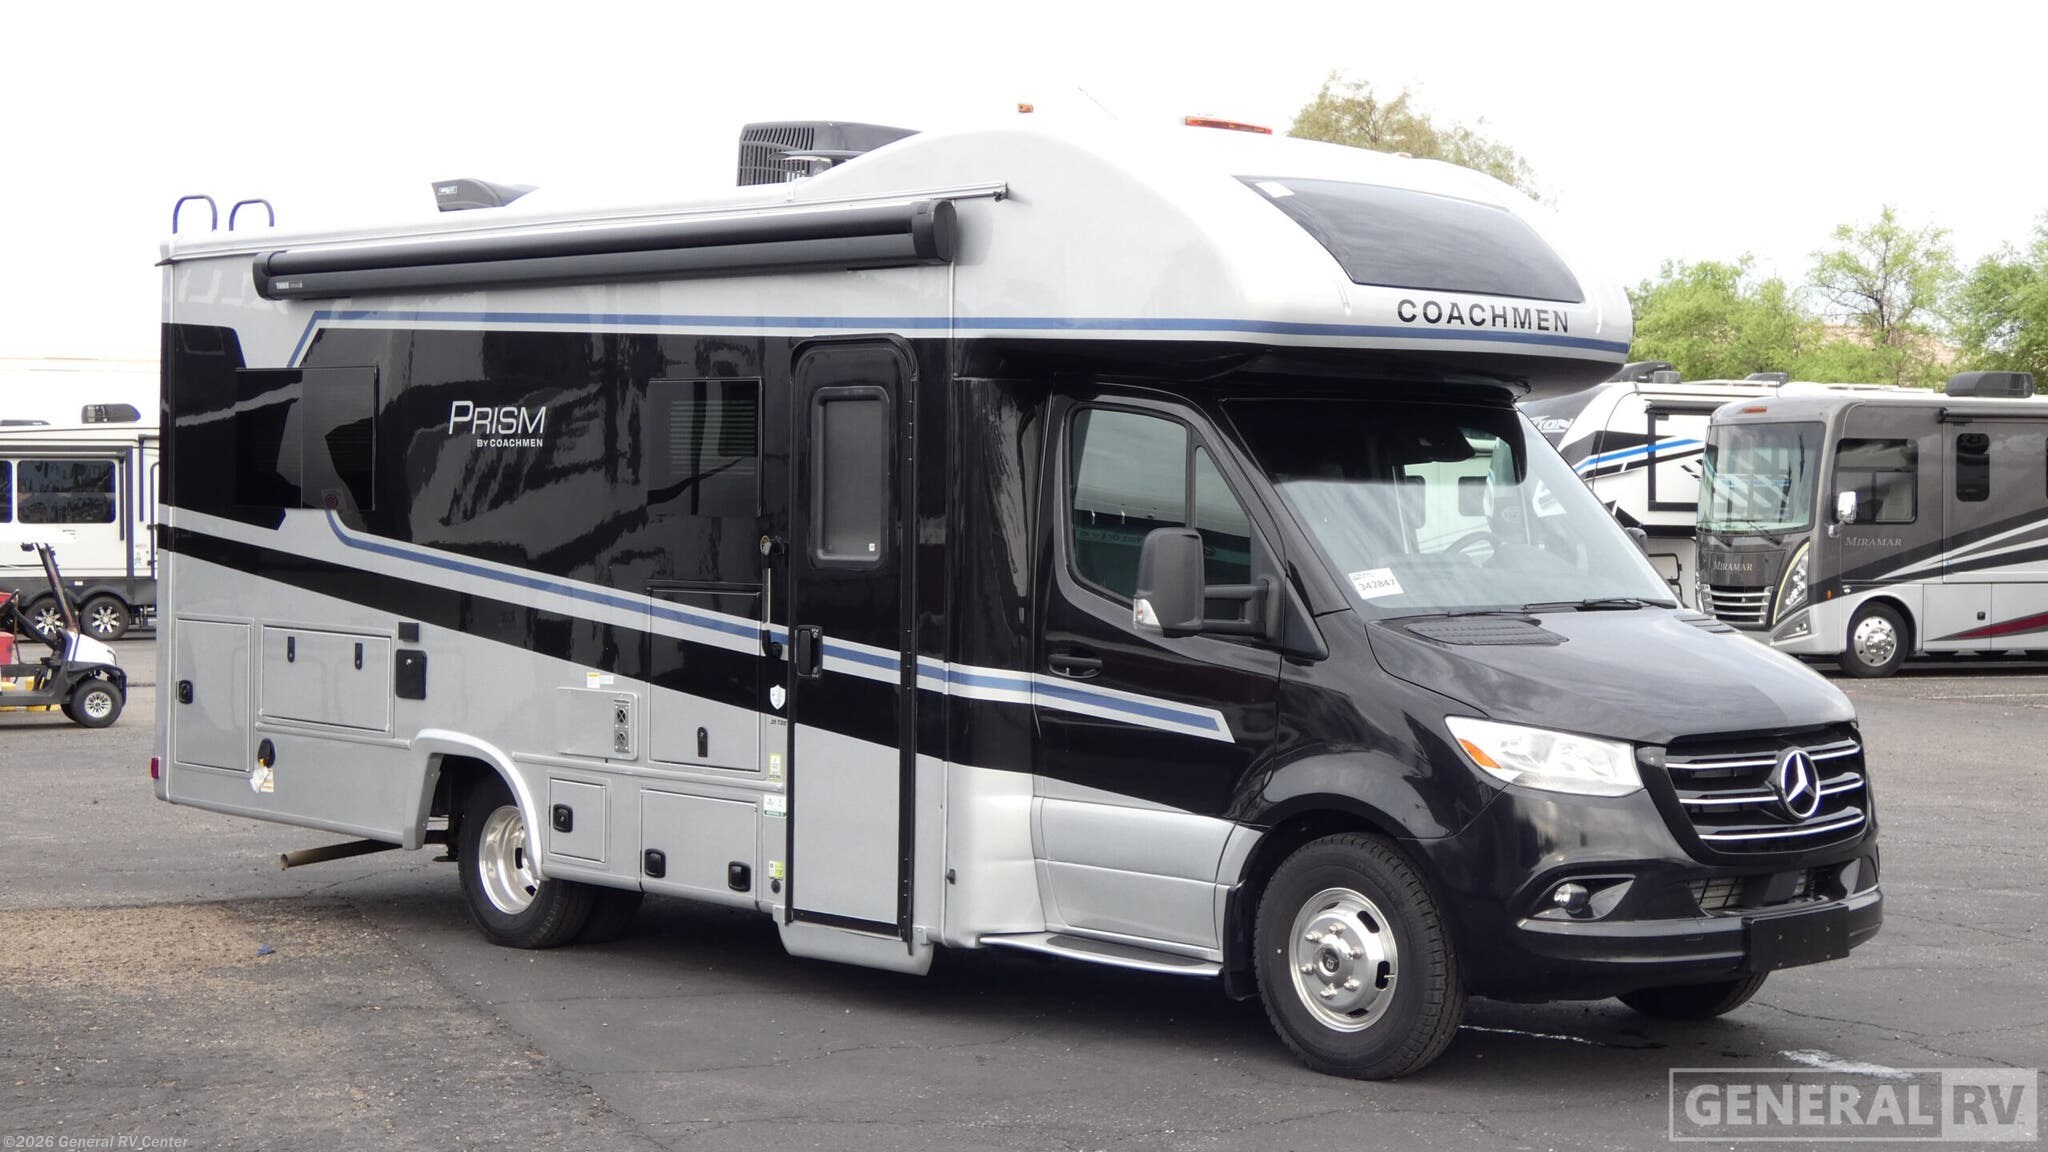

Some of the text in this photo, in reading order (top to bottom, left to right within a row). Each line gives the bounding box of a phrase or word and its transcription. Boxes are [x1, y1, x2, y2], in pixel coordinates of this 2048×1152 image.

[1398, 299, 1568, 333] COACHMEN
[489, 438, 543, 447] COACHMEN
[1845, 536, 1902, 547] MIRAMAR
[1713, 560, 1753, 572] MIRAMAR
